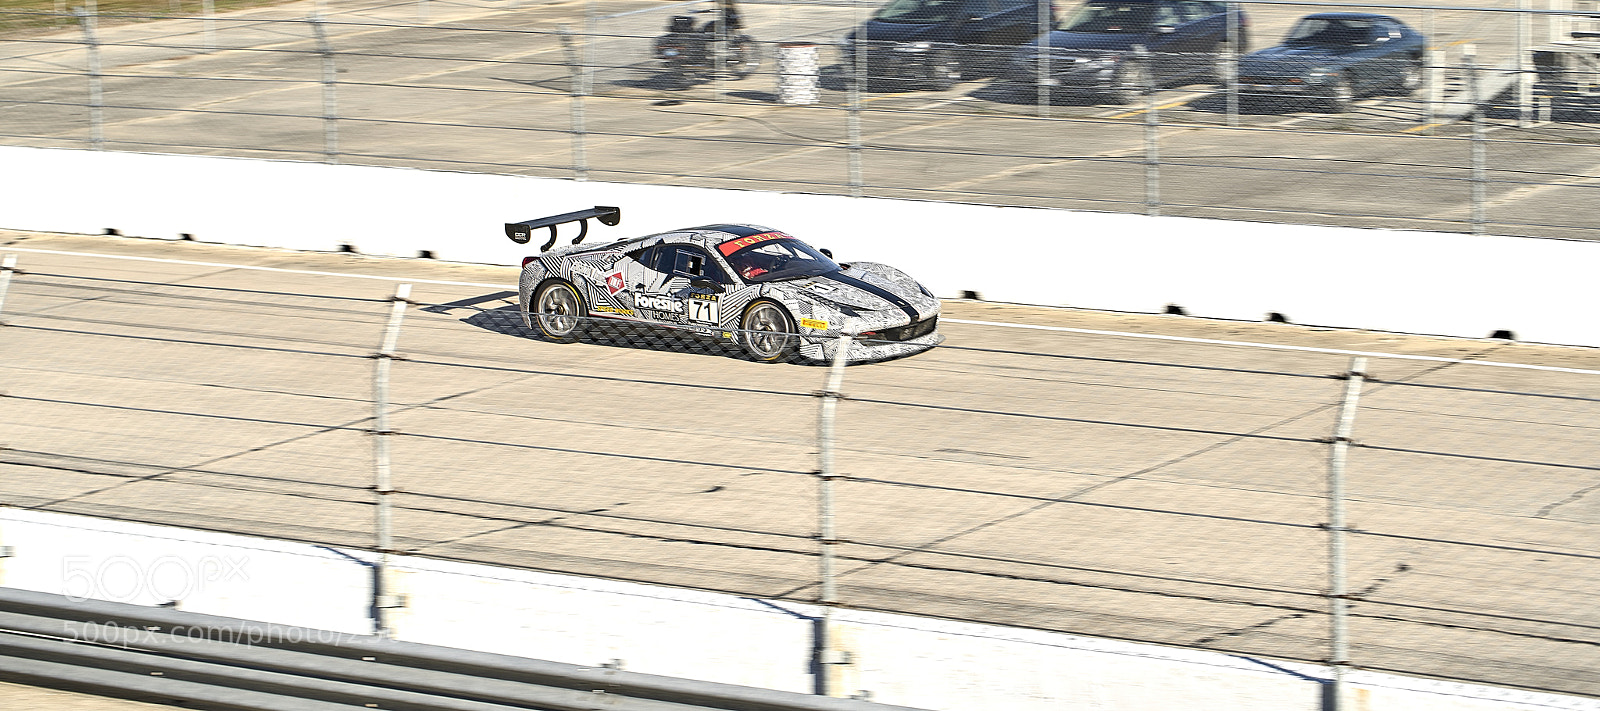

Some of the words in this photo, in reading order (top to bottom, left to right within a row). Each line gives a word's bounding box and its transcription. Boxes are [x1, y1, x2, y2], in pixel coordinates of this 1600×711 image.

[734, 233, 786, 248] FORZA
[634, 291, 684, 313] Foresite
[693, 300, 712, 321] 71
[652, 310, 680, 322] HOMES
